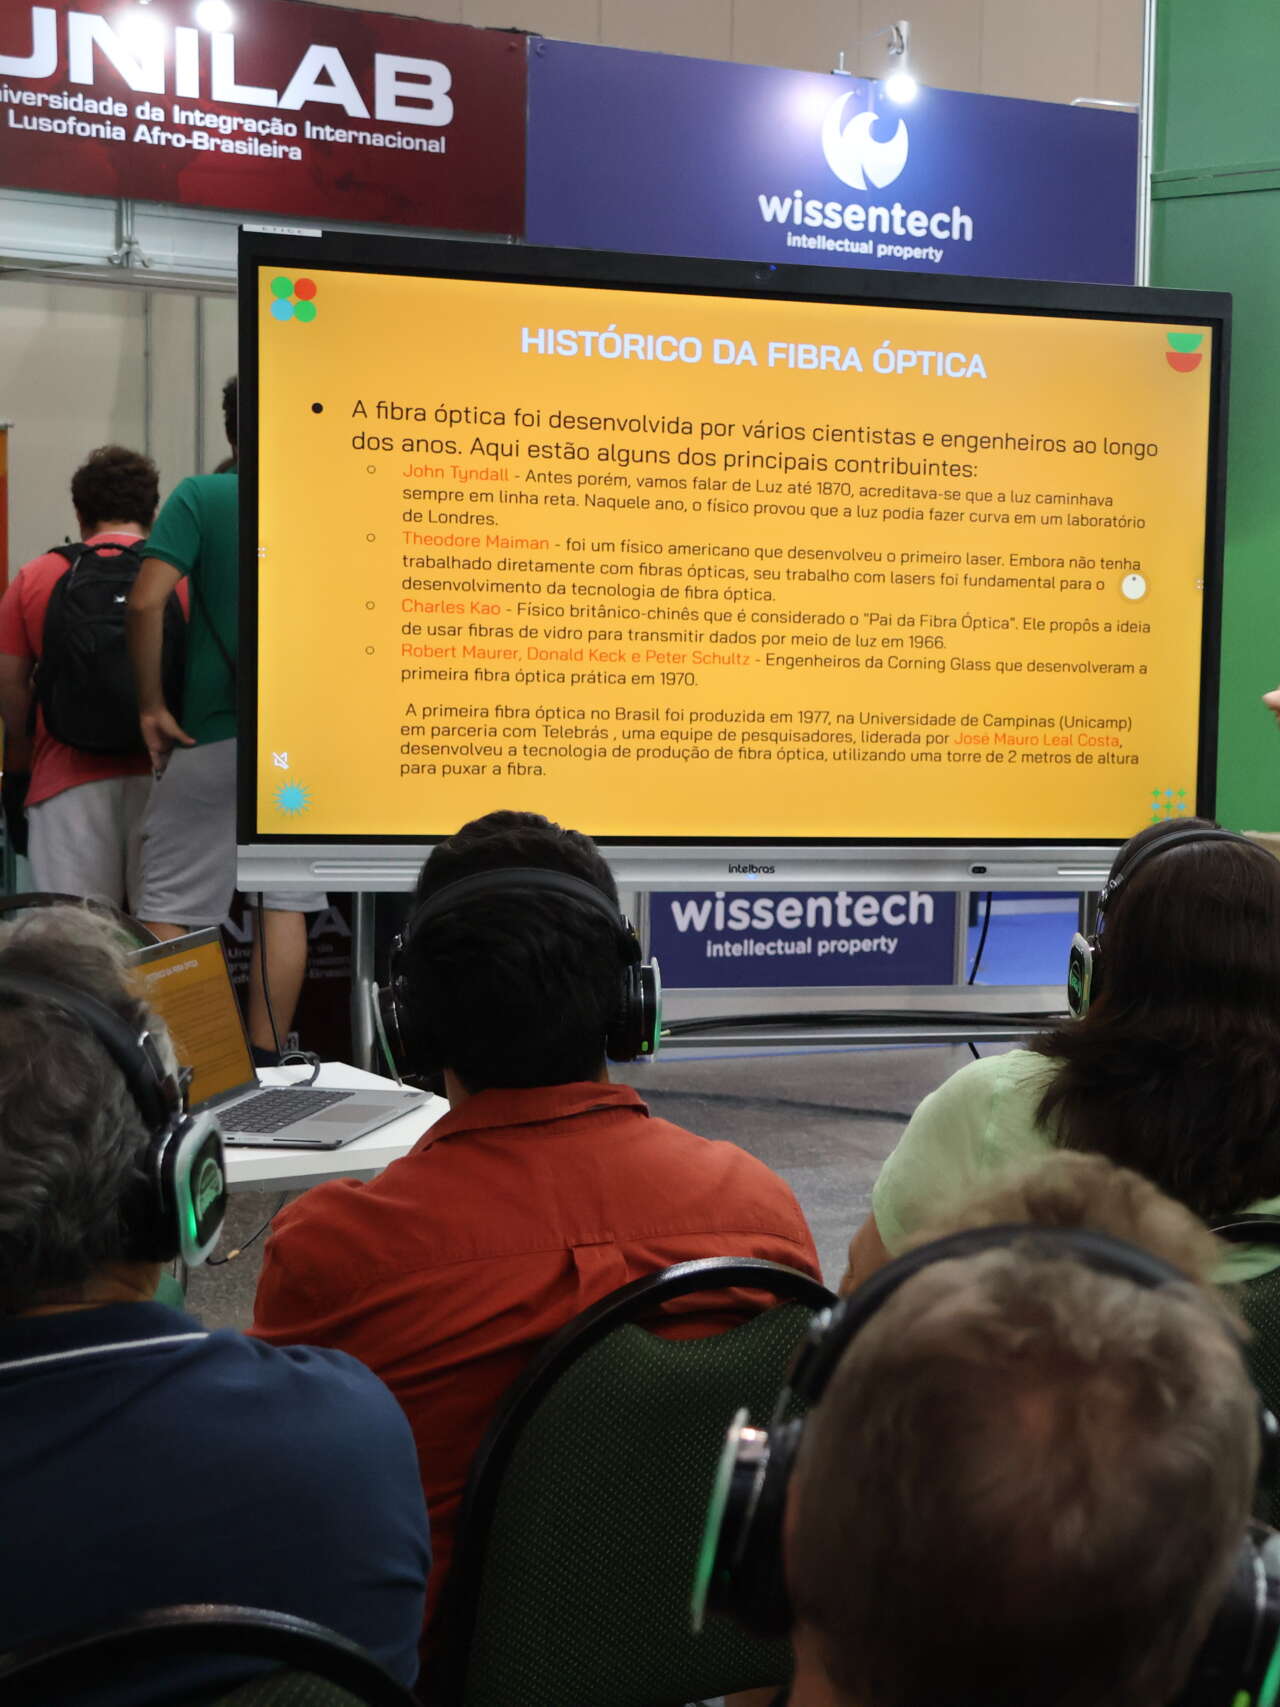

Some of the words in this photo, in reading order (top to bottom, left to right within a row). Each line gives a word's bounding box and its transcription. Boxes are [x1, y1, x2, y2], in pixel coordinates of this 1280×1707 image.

[8, 109, 126, 141] Lusofonia
[134, 125, 302, 161] Afro-Brasileira
[135, 101, 165, 122] da
[173, 105, 297, 138] Integração
[304, 121, 446, 154] Internacional
[758, 190, 973, 241] wissentech
[787, 232, 873, 255] intellectual
[877, 242, 943, 263] property
[522, 324, 702, 362] HISTÓRICO
[713, 338, 758, 365] DA
[769, 342, 864, 371] FIBRA
[874, 340, 987, 378] ÓPTICA
[351, 399, 368, 419] A
[375, 399, 426, 422] fibra
[434, 402, 506, 428] óptica
[513, 407, 541, 428] foi
[548, 409, 693, 435] desenvolvida
[700, 422, 736, 440] por
[741, 419, 806, 441] vários
[812, 423, 916, 446] cientistas
[922, 432, 935, 447] e
[940, 432, 1067, 453] engenheiros
[1072, 439, 1097, 454] ao
[1103, 436, 1158, 461] longo
[351, 431, 394, 452] dos
[401, 437, 462, 455] anos.
[469, 436, 519, 462] Aqui
[527, 441, 590, 461] estão
[596, 442, 671, 468] alguns
[677, 446, 716, 467] dos
[723, 450, 828, 475] principais
[834, 456, 978, 478] contribuintes:
[402, 463, 444, 479] John
[450, 465, 508, 483] Tyndall
[524, 469, 573, 485] Antes
[577, 471, 631, 488] porém,
[636, 477, 687, 489] vamos
[692, 475, 728, 491] falar
[731, 478, 751, 492] de
[755, 479, 783, 494] Luz
[786, 480, 812, 495] até
[816, 481, 854, 498] 1870,
[858, 484, 961, 501] acreditava-se
[965, 491, 993, 504] que
[996, 492, 1006, 503] a
[1010, 489, 1031, 504] luz
[1035, 492, 1113, 507] caminhava
[402, 488, 464, 504] sempre
[469, 491, 494, 503] em
[499, 489, 539, 505] linha
[543, 492, 580, 507] reta.
[584, 492, 650, 512] Naquele
[655, 499, 687, 513] ano,
[692, 500, 702, 512] o
[706, 497, 749, 514] físico
[753, 503, 805, 517] provou
[809, 505, 838, 520] que
[842, 507, 852, 518] a
[856, 504, 878, 519] luz
[882, 506, 924, 522] podia
[928, 507, 965, 522] fazer
[969, 511, 1010, 524] curva
[1013, 513, 1036, 525] em
[1040, 515, 1063, 526] um
[1066, 512, 1146, 529] laboratório
[402, 507, 423, 523] de
[428, 509, 498, 526] Londres.
[402, 554, 492, 571] trabalhado
[497, 556, 595, 574] diretamente
[599, 563, 634, 575] com
[638, 561, 683, 577] fibras
[687, 563, 749, 581] ópticas,
[753, 568, 781, 580] seu
[785, 567, 850, 583] trabalho
[853, 572, 886, 584] com
[890, 570, 936, 586] lasers
[940, 572, 959, 586] foi
[963, 572, 1056, 589] fundamental
[1059, 579, 1092, 593] para
[1095, 580, 1105, 591] o
[401, 598, 465, 614] Charles
[470, 601, 501, 615] Kao
[516, 601, 564, 617] Físico
[569, 603, 699, 621] britânico-chinês
[703, 610, 733, 624] que
[736, 608, 746, 623] é
[751, 610, 845, 625] considerado
[849, 614, 859, 626] o
[863, 612, 892, 627] "Pai
[896, 613, 916, 627] da
[919, 613, 957, 628] Fibra
[961, 611, 1018, 631] Óptica".
[1022, 616, 1046, 631] Ele
[1049, 617, 1100, 634] propôs
[1103, 622, 1112, 632] a
[1116, 619, 1151, 634] ideia
[401, 621, 422, 636] de
[427, 625, 463, 637] usar
[467, 622, 514, 638] fibras
[518, 624, 539, 639] de
[543, 625, 583, 640] vidro
[587, 629, 623, 644] para
[627, 628, 705, 643] transmitir
[708, 629, 757, 645] dados
[760, 634, 787, 648] por
[790, 633, 828, 647] meio
[832, 633, 851, 647] de
[855, 633, 877, 648] luz
[881, 637, 904, 648] em
[908, 634, 946, 649] 1966.
[400, 666, 468, 683] primeira
[473, 667, 510, 682] fibra
[514, 667, 566, 686] óptica
[570, 669, 626, 687] prática
[631, 674, 655, 685] em
[659, 671, 698, 687] 1970.
[405, 702, 417, 717] A
[422, 703, 489, 720] primeira
[494, 703, 530, 719] fibra
[535, 704, 586, 722] óptica
[590, 709, 610, 720] no
[615, 706, 660, 721] Brasil
[664, 707, 684, 722] foi
[689, 708, 765, 725] produzida
[769, 712, 792, 724] em
[797, 710, 831, 726] 1977,
[836, 713, 854, 725] na
[859, 711, 957, 727] Universidade
[960, 713, 979, 727] de
[982, 712, 1055, 730] Campinas
[1058, 715, 1132, 732] (Unicamp)
[400, 763, 437, 778] para
[441, 763, 488, 778] puxar
[491, 764, 501, 776] a
[506, 761, 546, 776] fibra.
[728, 864, 775, 874] intelbras
[671, 891, 934, 932] wissentech
[706, 937, 812, 957] intellectual
[817, 936, 898, 955] property
